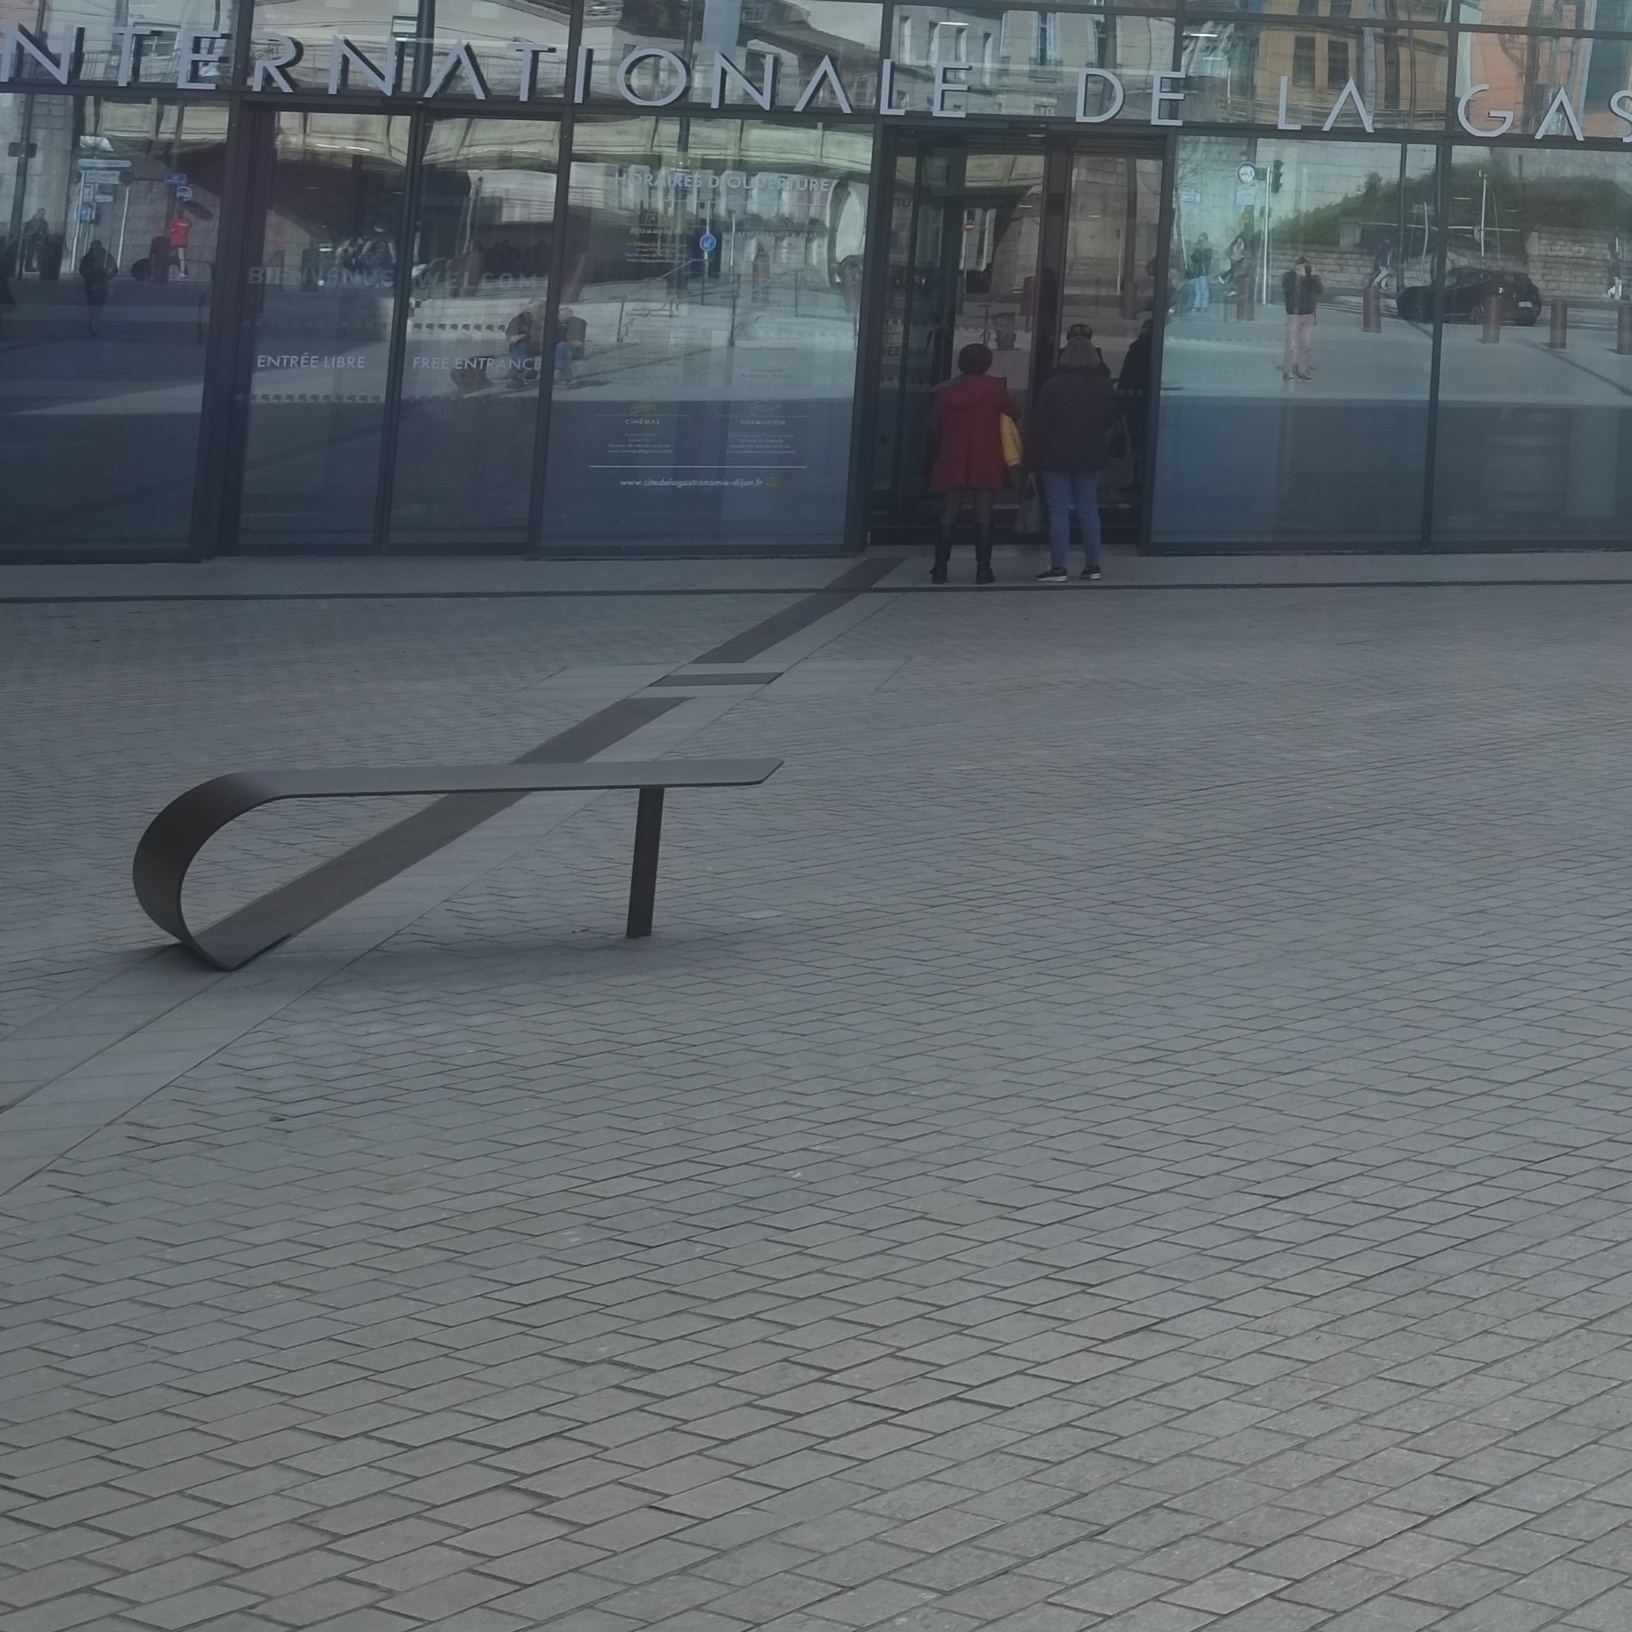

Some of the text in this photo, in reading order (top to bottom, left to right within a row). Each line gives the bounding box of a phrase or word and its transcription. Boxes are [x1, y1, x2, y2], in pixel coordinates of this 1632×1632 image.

[1075, 69, 1186, 127] DE
[1277, 76, 1375, 133] LA
[614, 170, 703, 189] HORAIRES
[256, 352, 367, 369] ENTRÉE LIBRE
[412, 356, 450, 370] FREE
